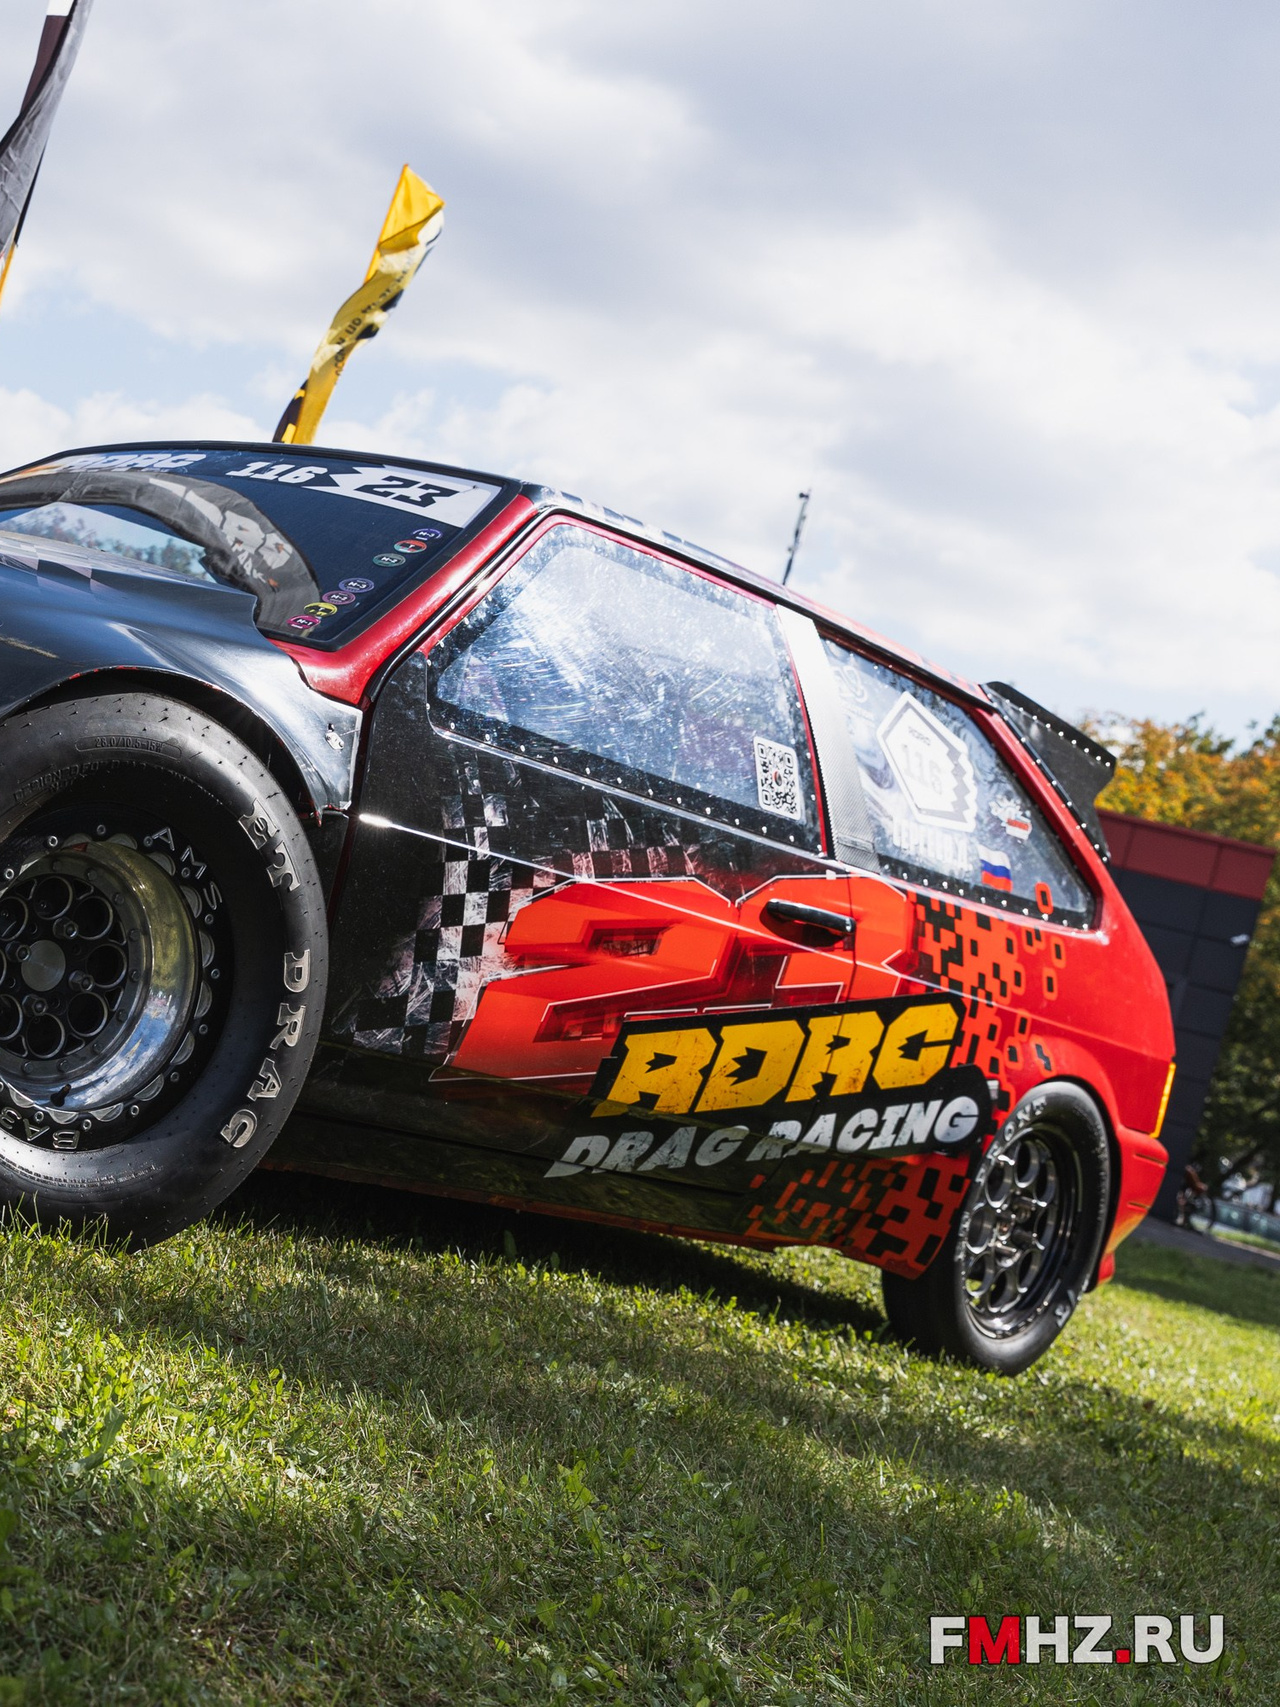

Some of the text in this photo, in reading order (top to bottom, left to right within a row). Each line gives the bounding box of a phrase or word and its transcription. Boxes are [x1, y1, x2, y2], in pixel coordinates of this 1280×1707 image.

[225, 461, 328, 483] 116
[353, 475, 460, 508] 23
[151, 827, 223, 911] AMS
[220, 798, 311, 1149] ET DRAG
[590, 1003, 960, 1118] RDRC
[543, 1096, 980, 1178] DRAG RACING
